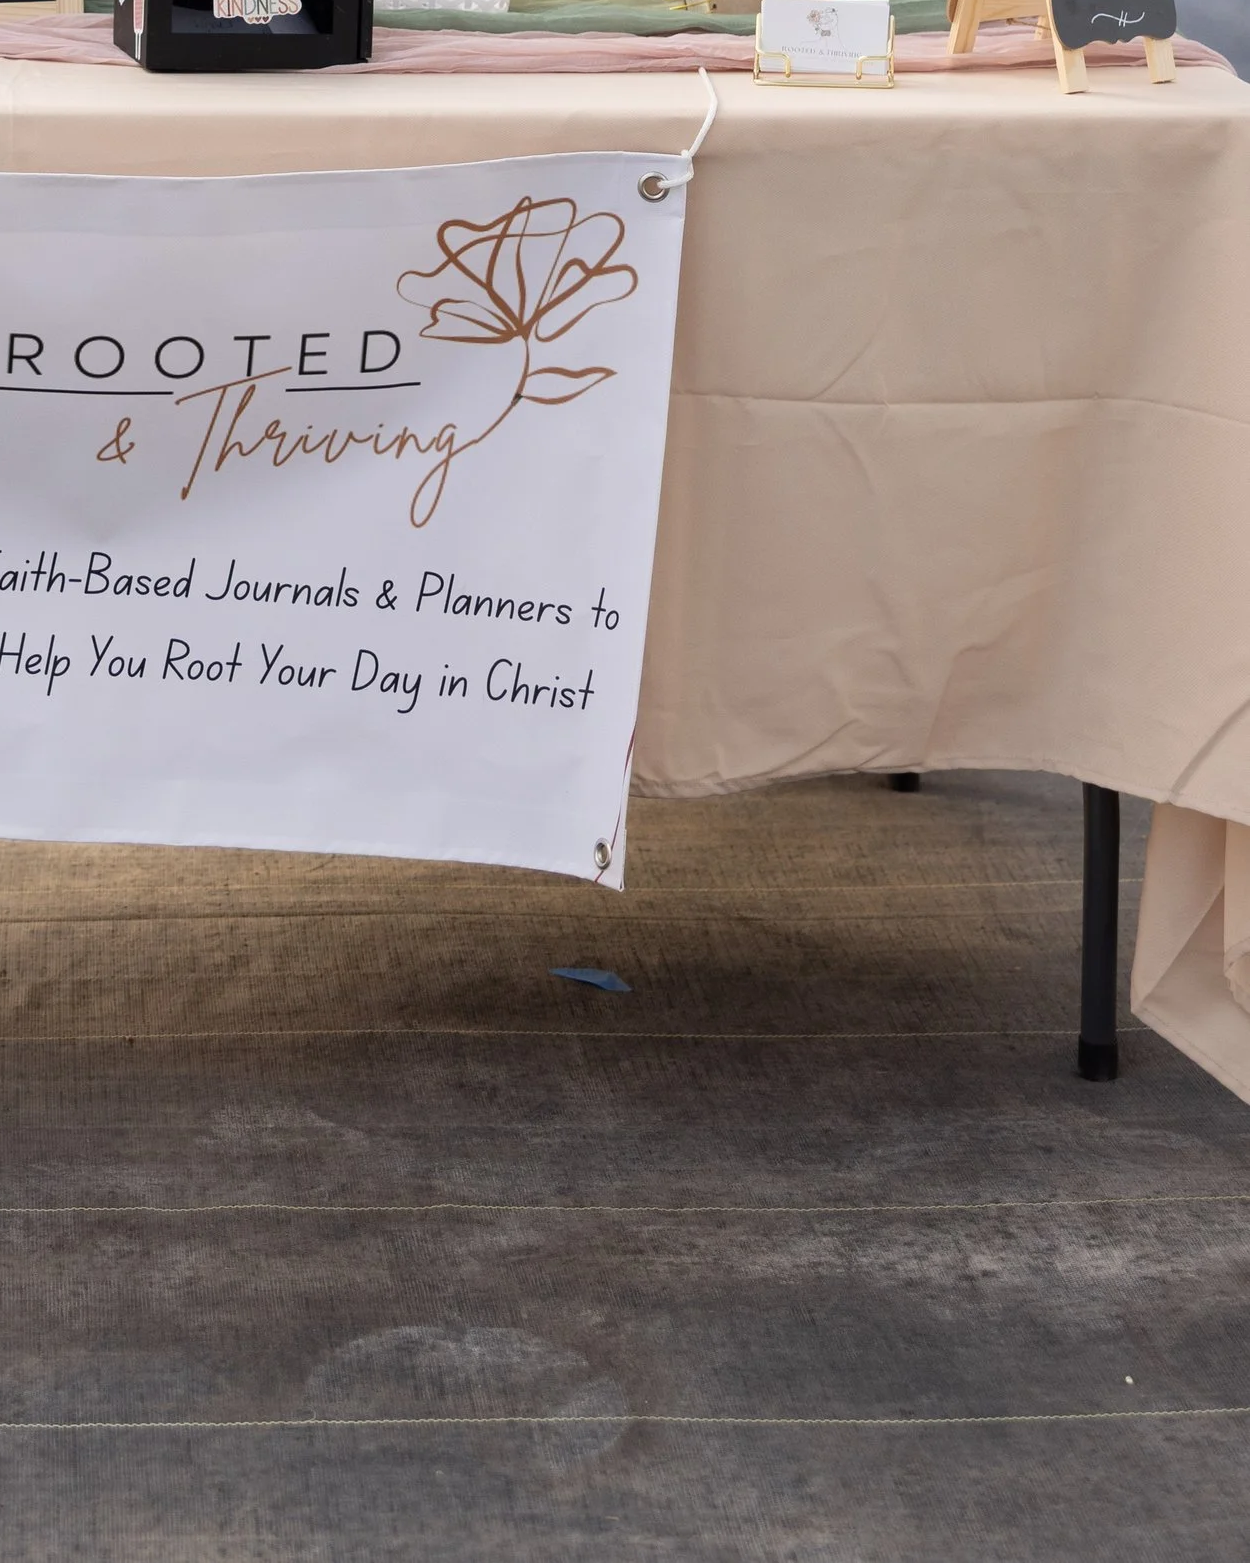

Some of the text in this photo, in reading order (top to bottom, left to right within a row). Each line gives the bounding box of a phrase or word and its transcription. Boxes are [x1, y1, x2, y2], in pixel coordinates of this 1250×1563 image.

[5, 329, 402, 379] ROOTED
[96, 366, 477, 528] & Thriving
[205, 559, 360, 608] Journals
[375, 579, 398, 610] &
[415, 571, 572, 625] Planners
[591, 587, 620, 631] to
[91, 634, 146, 679] You
[162, 638, 243, 683] Root
[261, 643, 336, 687] Your
[351, 649, 421, 713] Day
[438, 663, 467, 697] in
[486, 659, 595, 710] Christ
